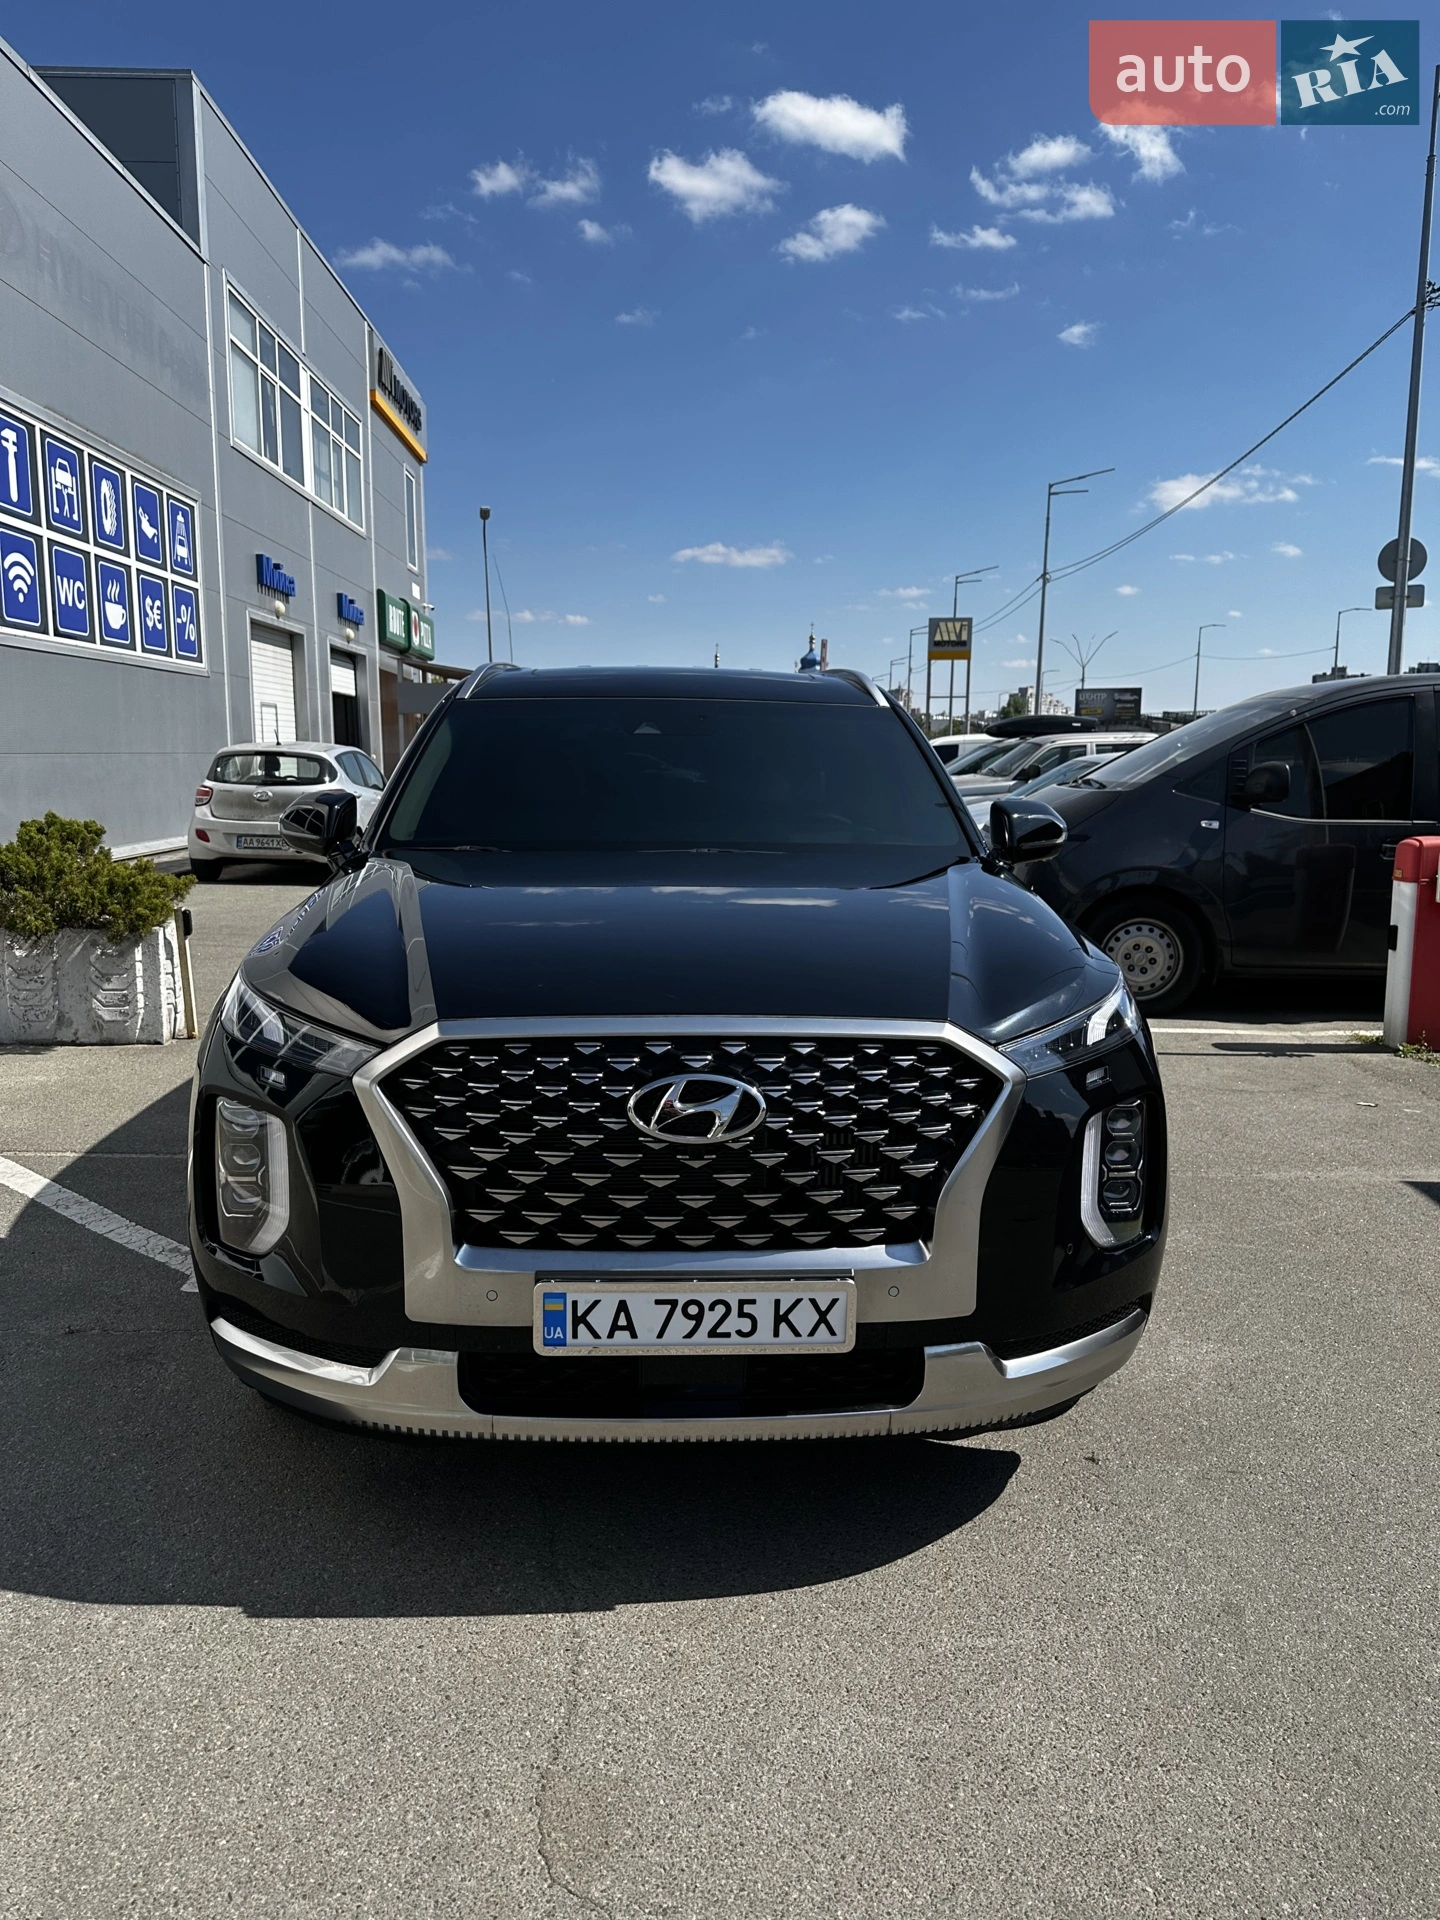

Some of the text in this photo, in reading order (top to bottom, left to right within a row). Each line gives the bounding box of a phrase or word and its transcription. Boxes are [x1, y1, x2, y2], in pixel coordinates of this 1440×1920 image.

[57, 575, 86, 611] WC
[243, 837, 254, 847] AA
[544, 1297, 840, 1340] UA KA 7925 KX
